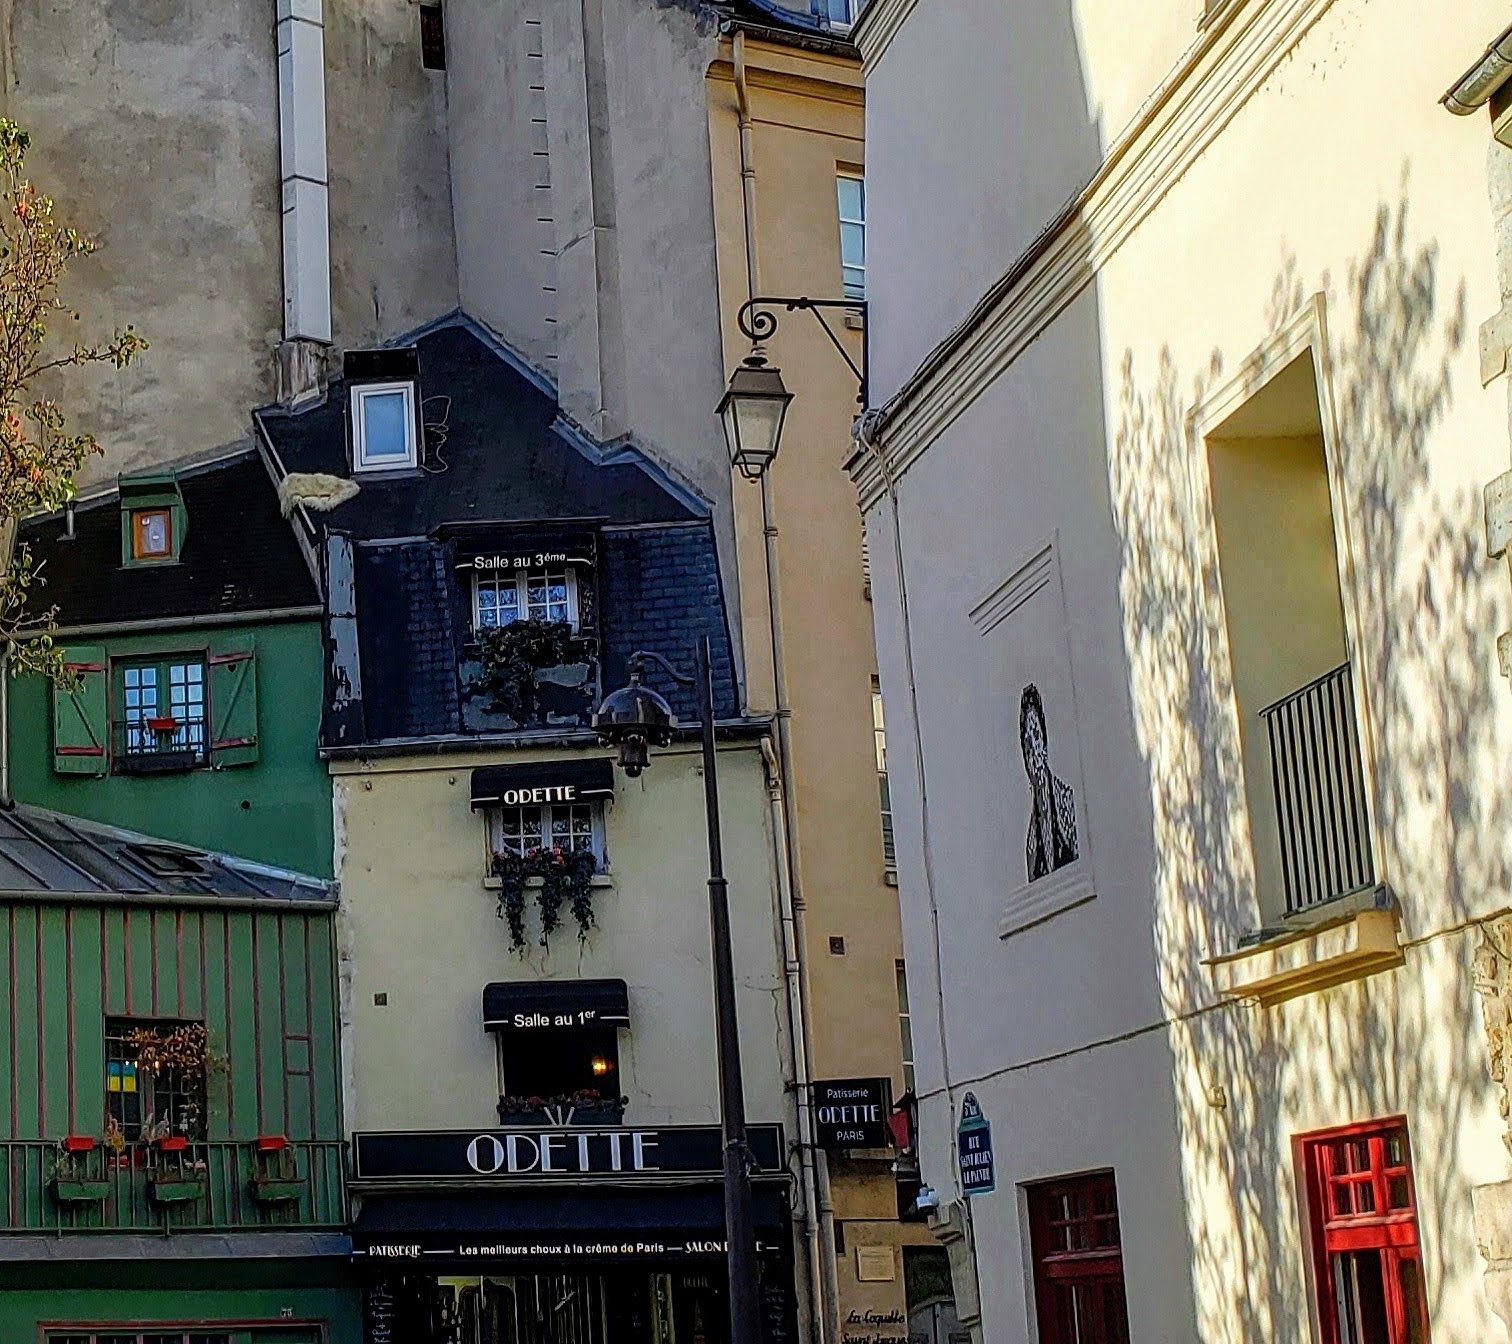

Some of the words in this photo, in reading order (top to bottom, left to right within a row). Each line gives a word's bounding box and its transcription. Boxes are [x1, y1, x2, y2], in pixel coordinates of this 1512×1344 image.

[474, 555, 509, 569] Salle
[513, 557, 531, 568] au
[503, 785, 576, 805] ODETTE
[513, 1012, 550, 1028] Salle
[554, 1014, 573, 1026] au
[577, 1010, 596, 1025] 1er
[818, 1104, 881, 1124] ODETTE
[836, 1130, 865, 1141] PARIS
[466, 1131, 661, 1174] ODETTE
[369, 1244, 422, 1258] PATISSERIE
[459, 1244, 478, 1255] Les
[480, 1244, 528, 1255] meilleurs
[530, 1243, 562, 1255] choux
[573, 1243, 583, 1254] la
[620, 1242, 634, 1253] de
[636, 1242, 664, 1253] Paris
[685, 1240, 722, 1254] SALON
